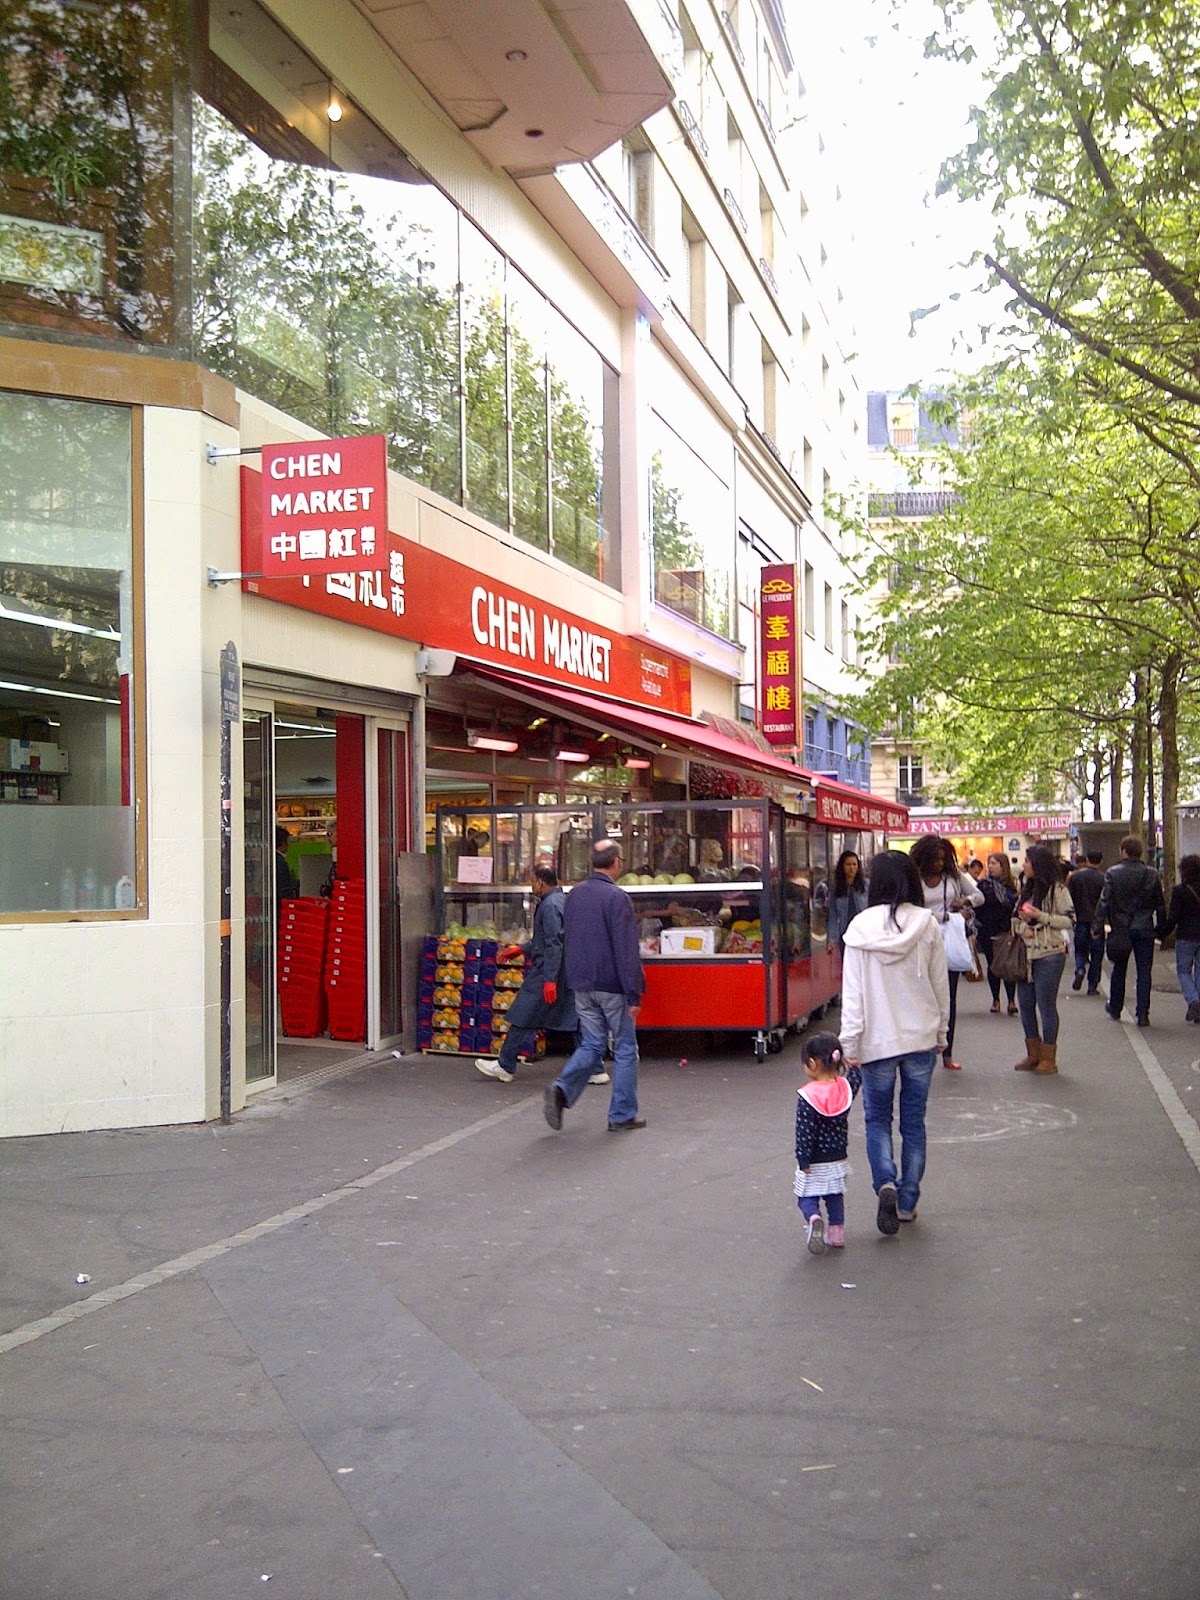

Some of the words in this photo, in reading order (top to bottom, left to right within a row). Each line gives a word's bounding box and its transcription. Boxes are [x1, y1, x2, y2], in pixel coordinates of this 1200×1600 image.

[270, 452, 342, 480] CHEN
[270, 487, 375, 517] MARKET
[470, 586, 537, 662] CHEN
[543, 613, 613, 685] MARKET
